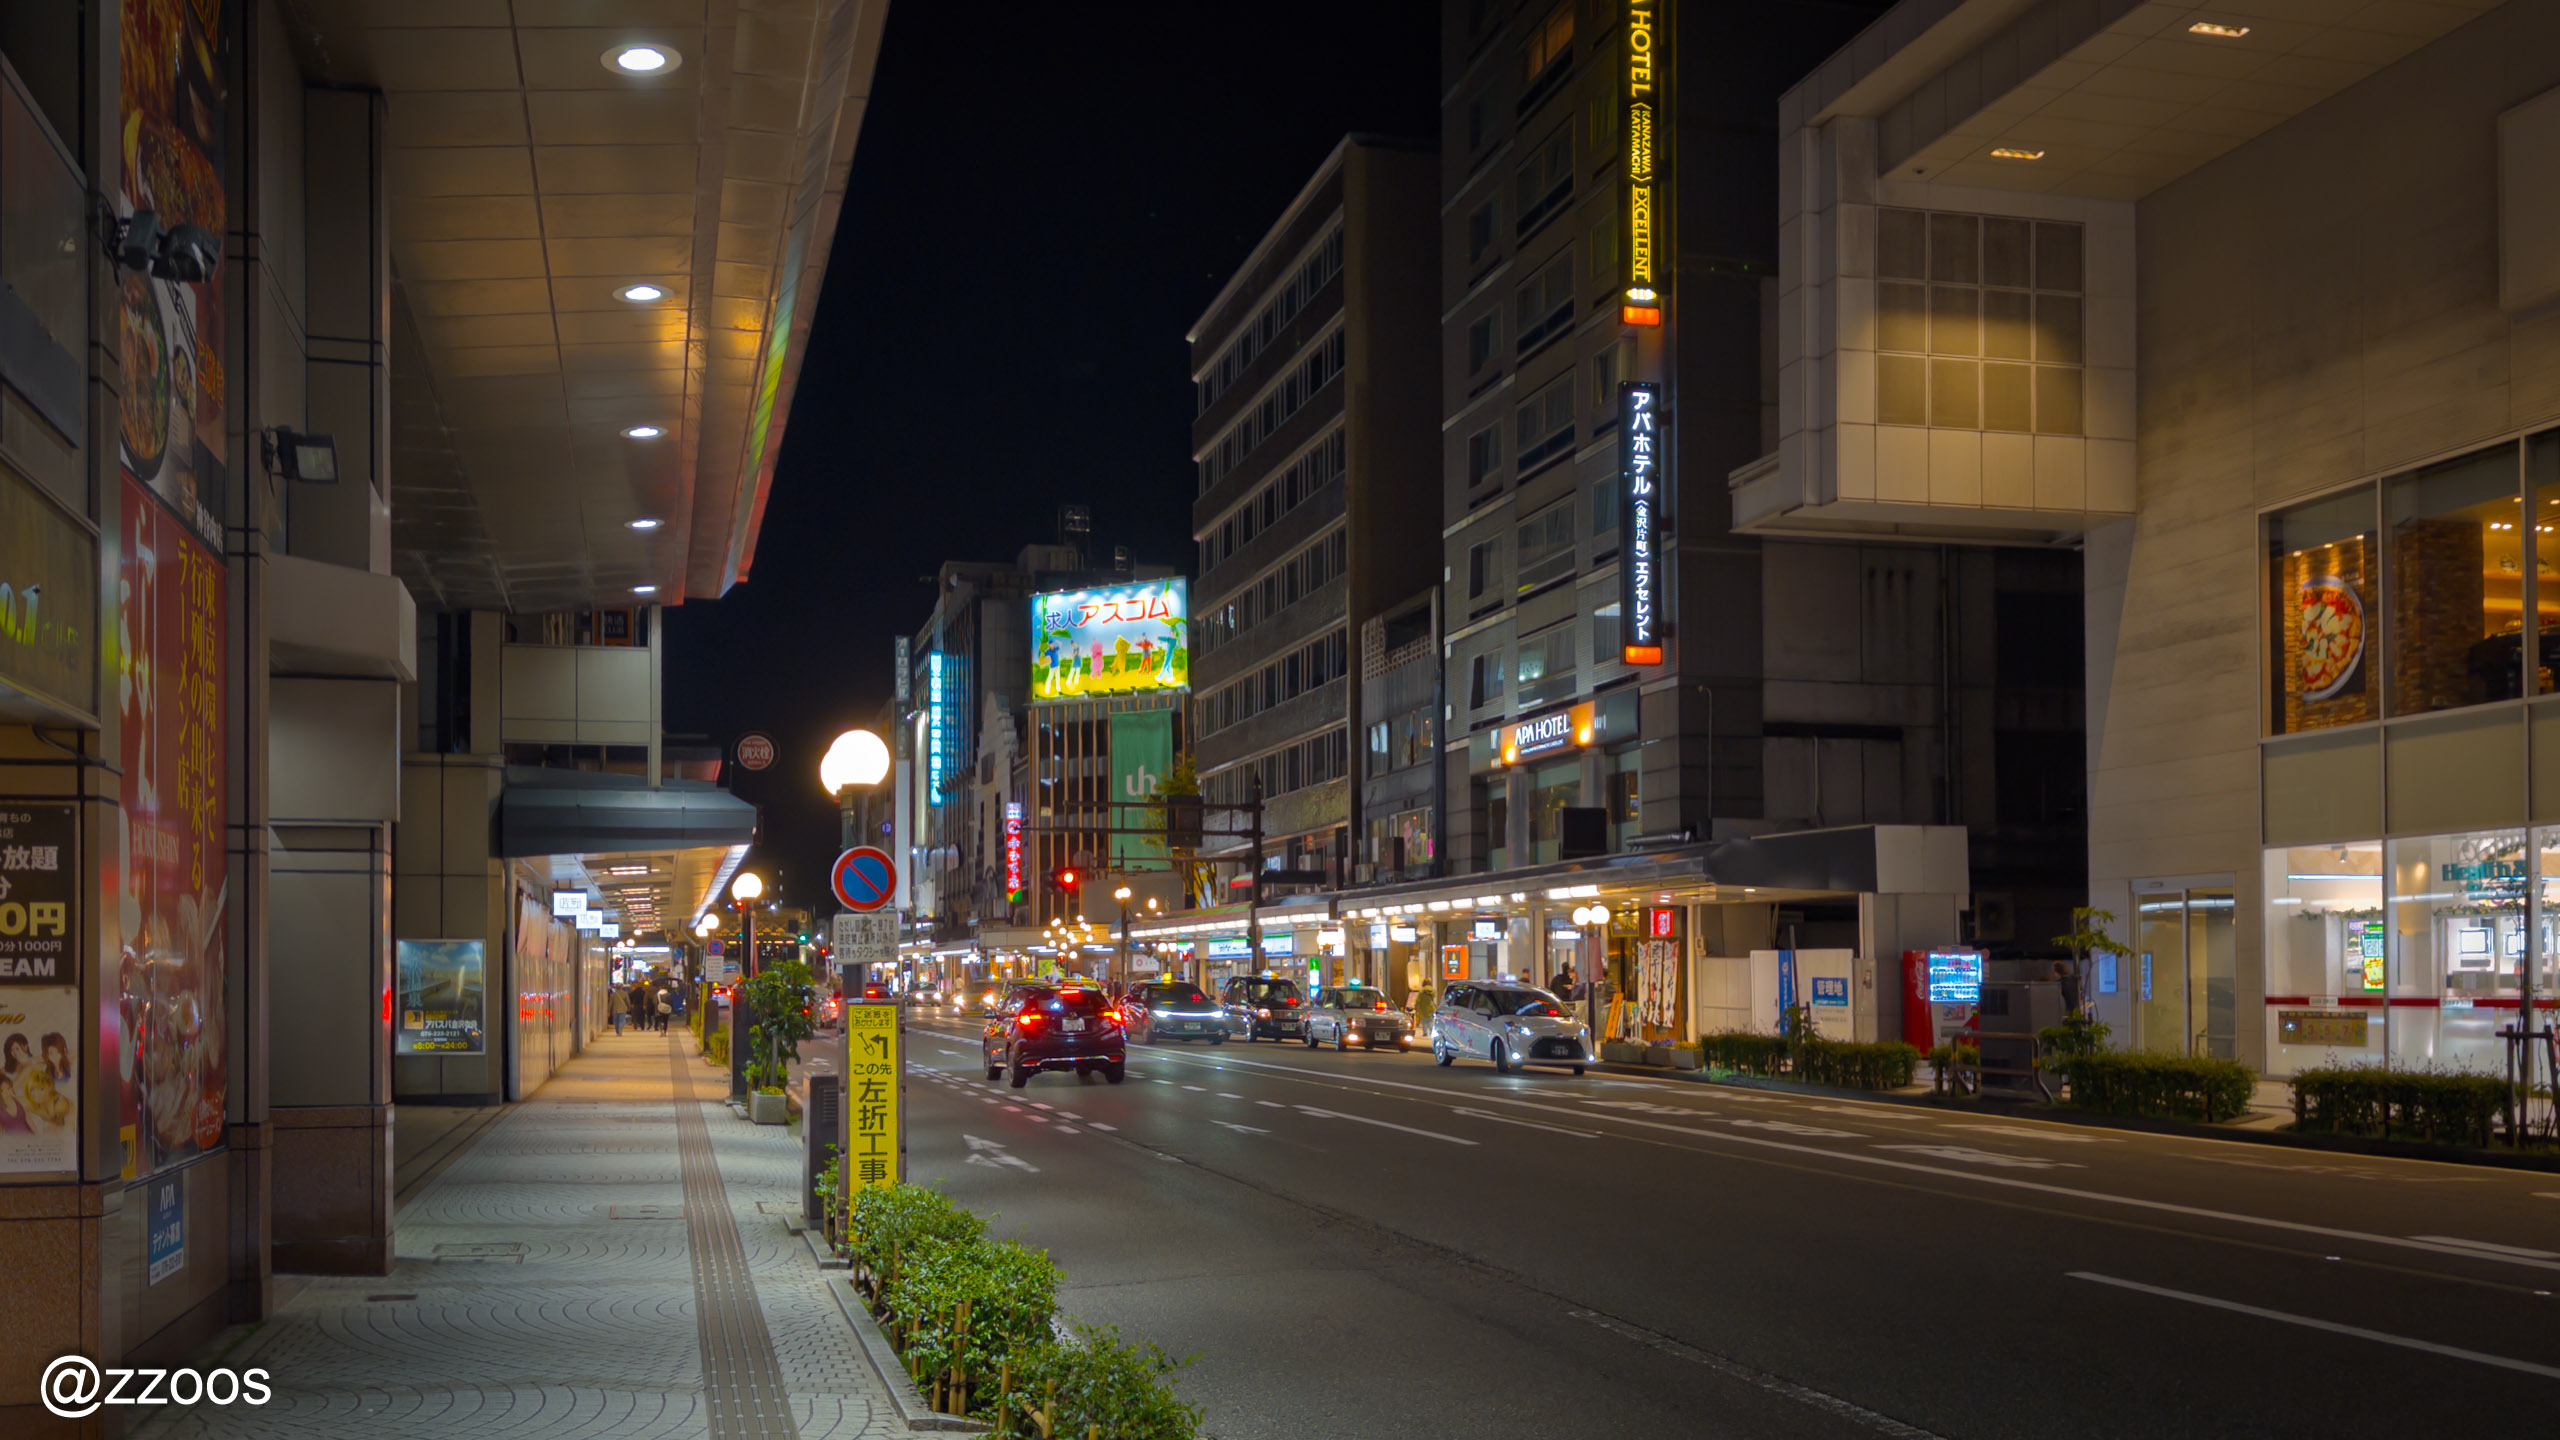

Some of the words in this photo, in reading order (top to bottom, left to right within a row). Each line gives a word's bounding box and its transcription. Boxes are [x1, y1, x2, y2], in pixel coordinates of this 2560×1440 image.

[1631, 9, 1650, 97] HOTEL
[1632, 109, 1640, 173] KATAMACHI
[1642, 110, 1651, 173] KANAZAWA
[1635, 187, 1648, 279] EXCELLENT
[177, 539, 190, 810] ラーメン店
[190, 551, 203, 890] 行列の出来る
[1515, 727, 1534, 746] APA
[1536, 713, 1570, 741] HOTEL
[0, 828, 14, 839] 店
[0, 845, 59, 871] 放題
[853, 1063, 892, 1075] この先
[858, 1078, 888, 1184] 左折工事
